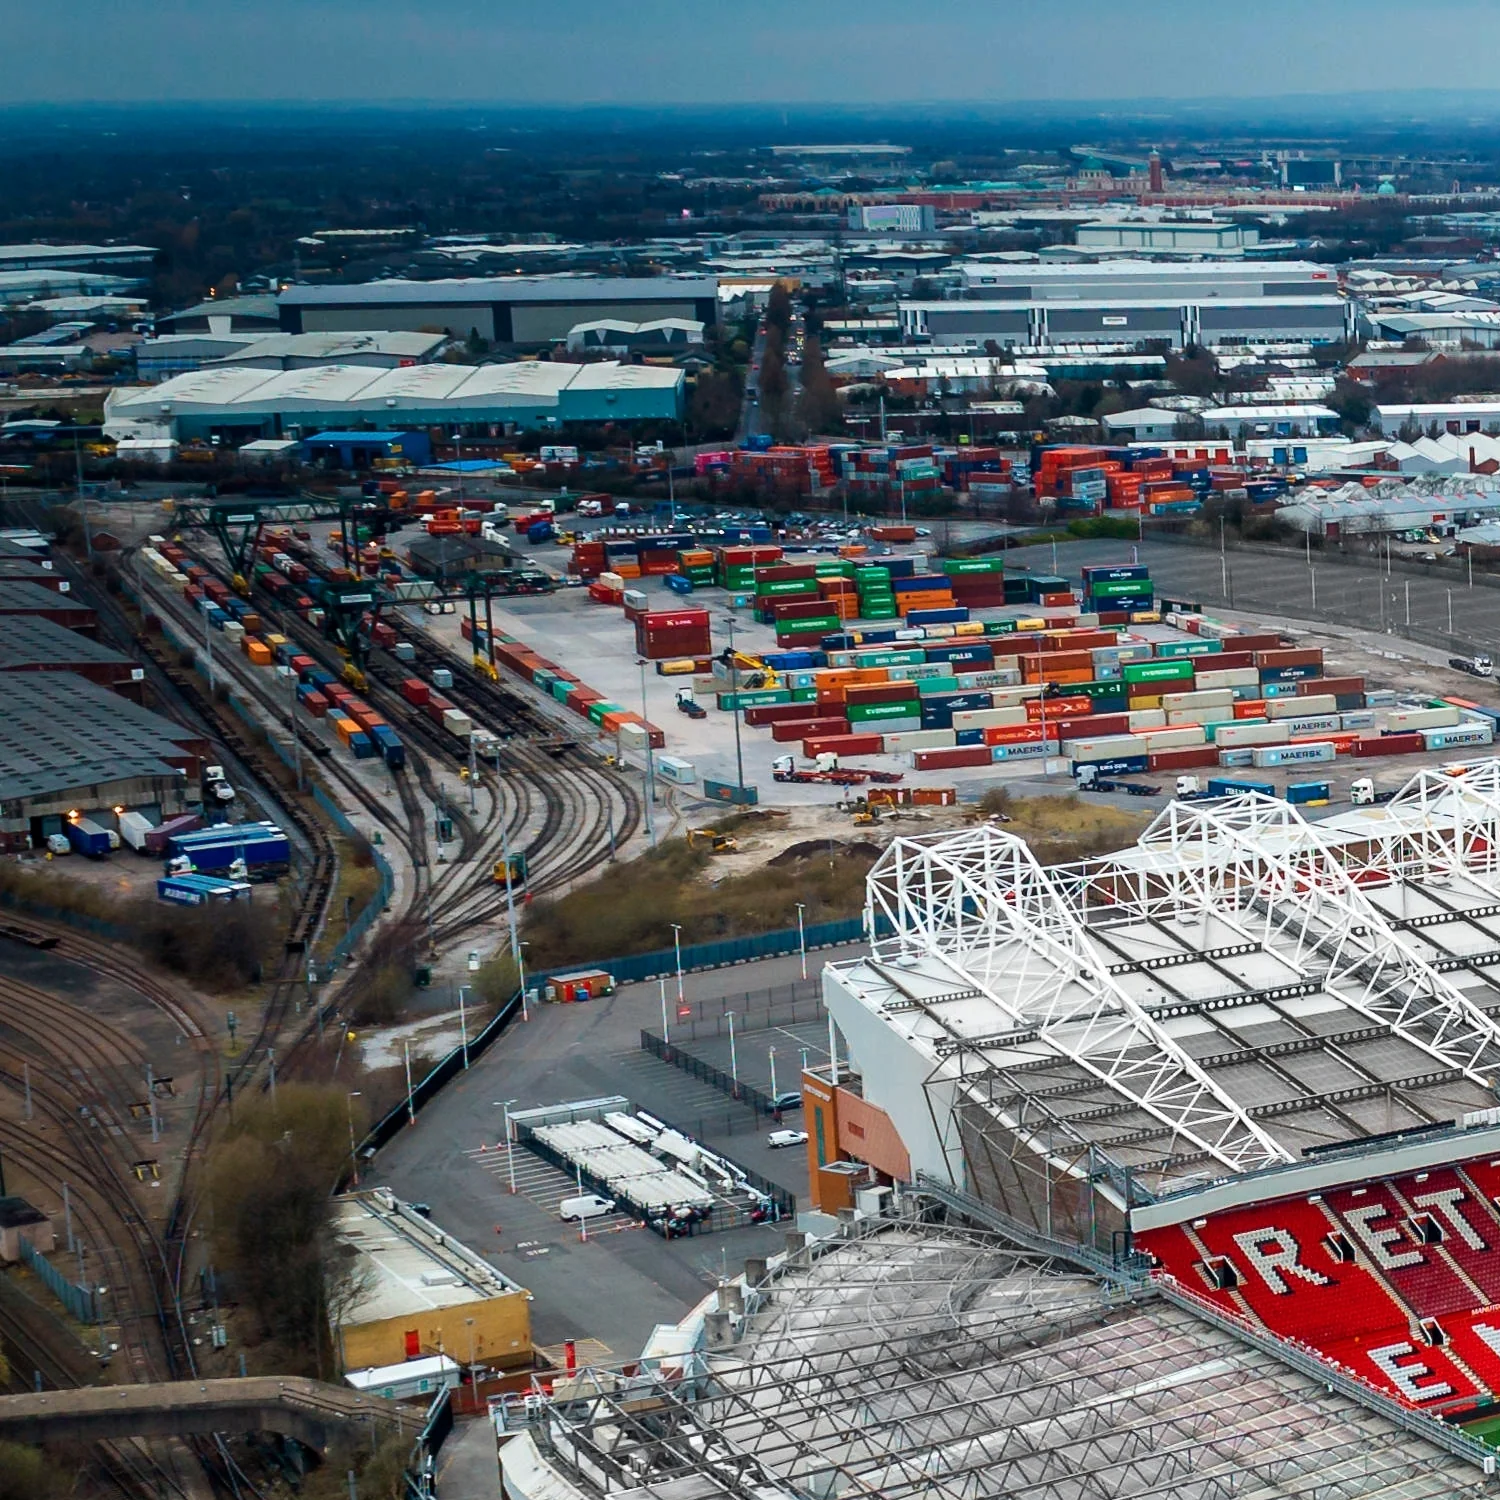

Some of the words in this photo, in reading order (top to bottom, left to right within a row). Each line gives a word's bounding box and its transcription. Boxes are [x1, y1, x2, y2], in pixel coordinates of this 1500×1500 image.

[1293, 720, 1333, 732] MAERSK
[1444, 732, 1484, 744] MAERSK
[1280, 749, 1323, 761] MAERSK
